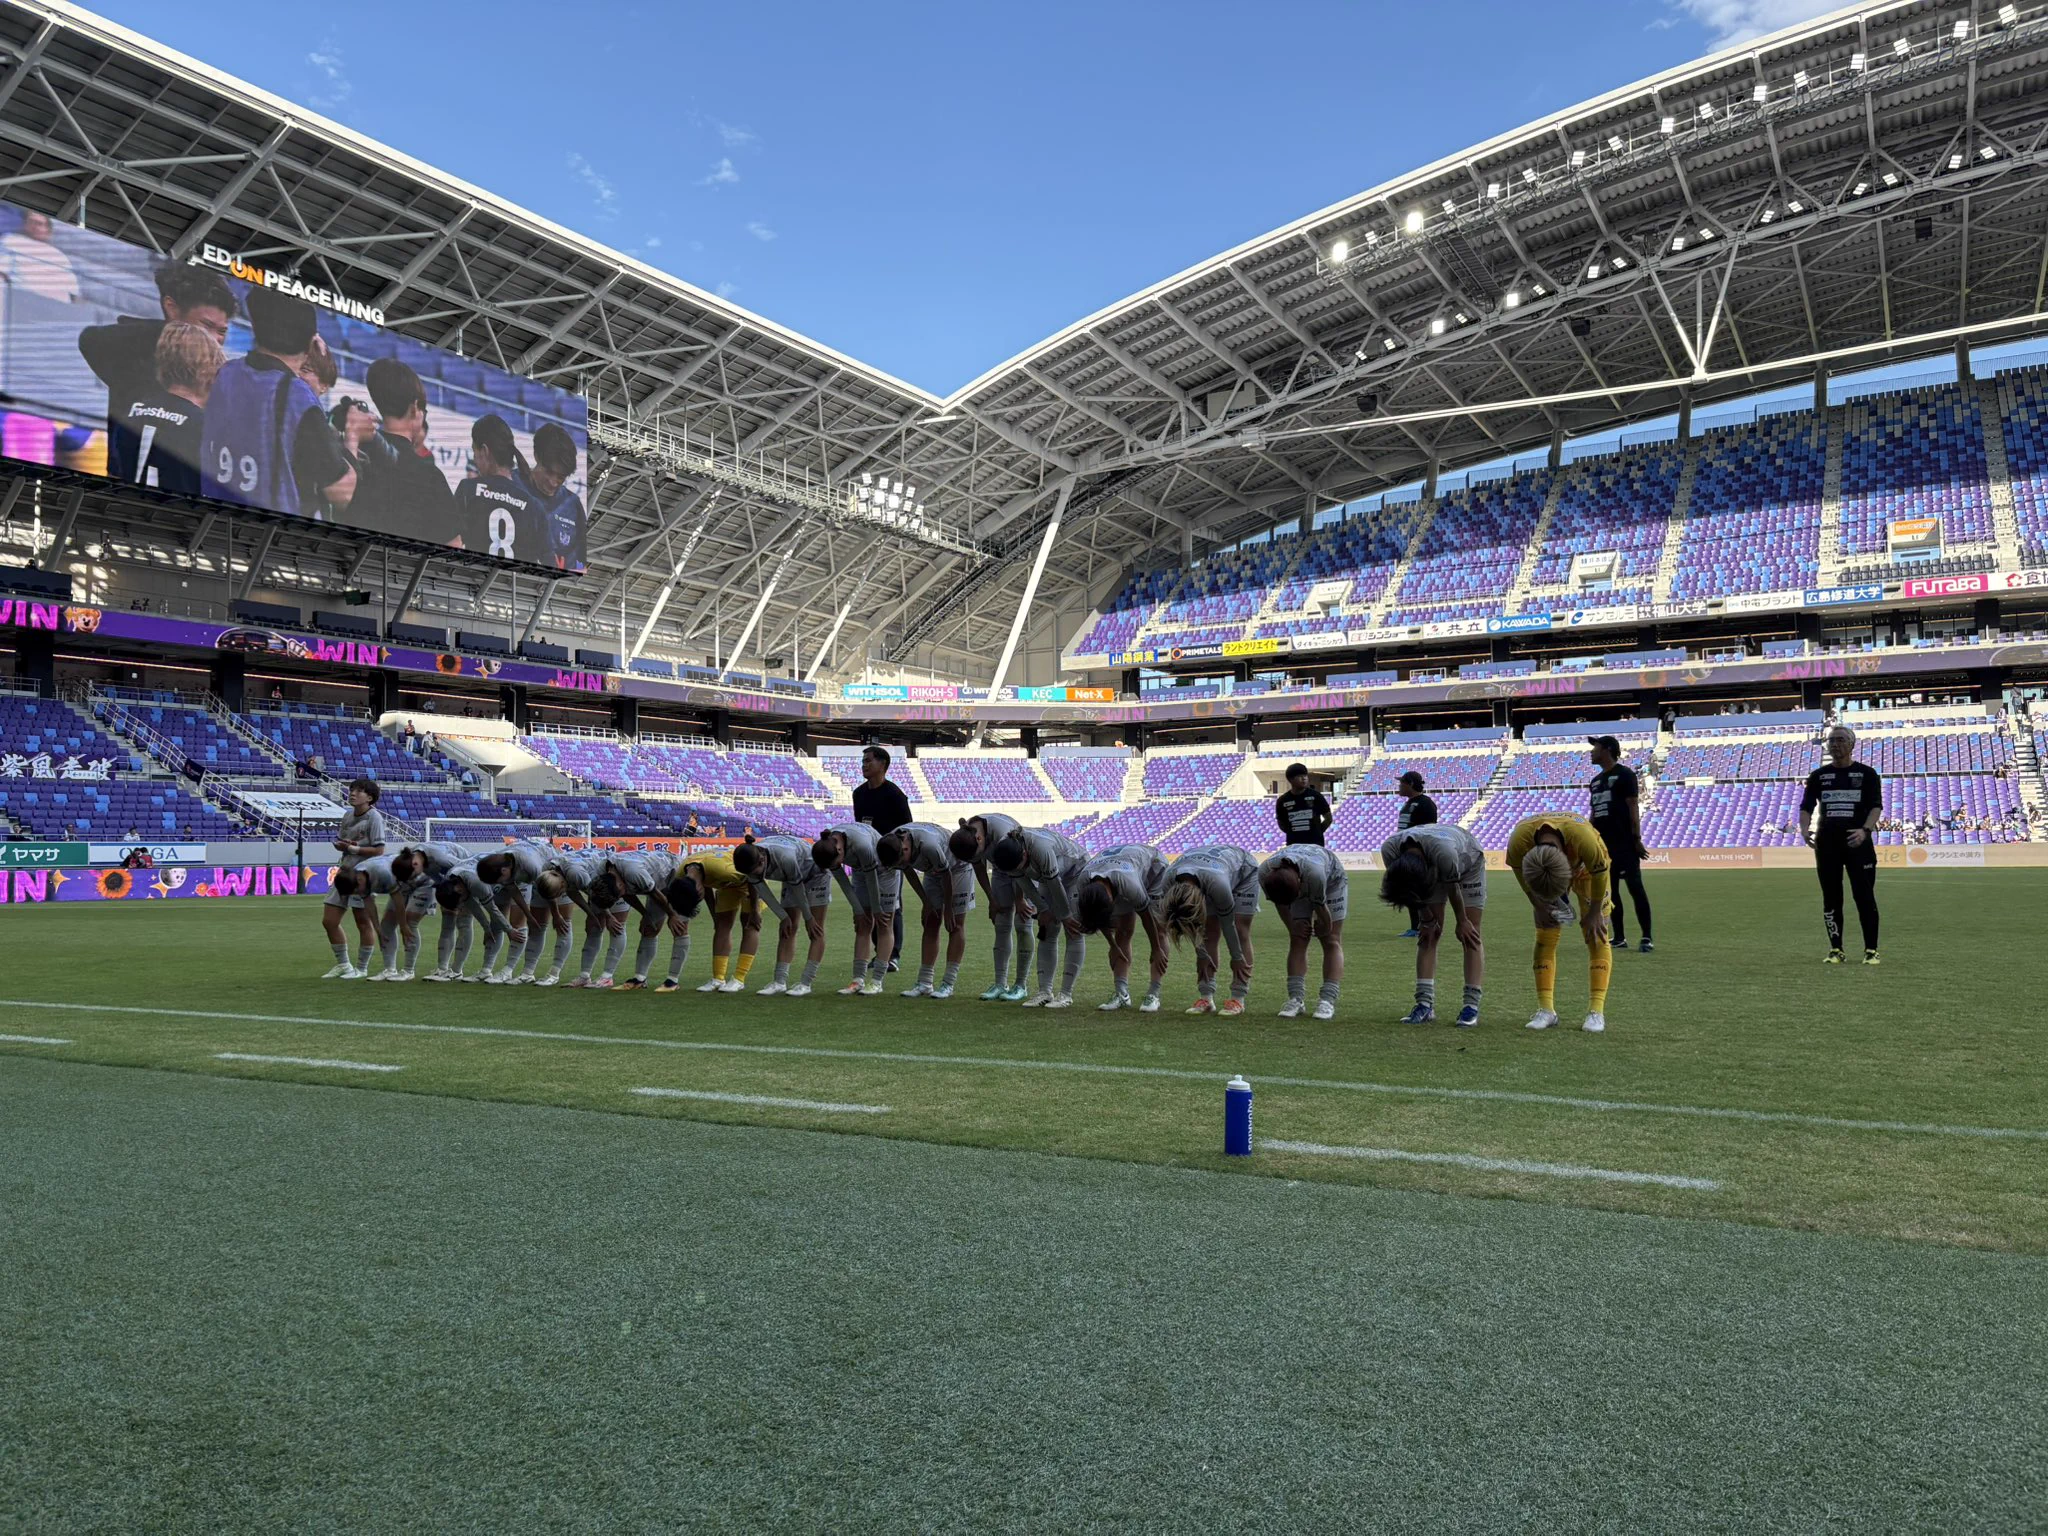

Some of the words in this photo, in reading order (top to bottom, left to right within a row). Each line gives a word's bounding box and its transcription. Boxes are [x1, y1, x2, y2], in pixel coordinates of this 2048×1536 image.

[476, 483, 527, 511] Forestway
[488, 508, 516, 559] 8
[1806, 586, 1881, 604] 広島修道大学
[1652, 601, 1707, 618] 福山大学
[1447, 622, 1482, 634] 共立
[1502, 616, 1549, 628] KAWADA
[317, 639, 378, 667] WIN
[1182, 647, 1222, 657] PRIMETALS
[1224, 641, 1277, 653] ランドクリエイト
[1786, 659, 1845, 679] WIN
[557, 669, 603, 691] WIN
[1525, 677, 1576, 693] WIN
[848, 687, 903, 696] WITHSOL
[911, 687, 953, 697] RIKOH-S
[1032, 689, 1053, 699] KEC
[1075, 689, 1104, 699] Net-X
[736, 693, 769, 711] WIN
[1300, 692, 1345, 710] WIN
[905, 706, 948, 720] WIN
[1105, 707, 1145, 721] WIN
[12, 848, 60, 862] ヤマサ
[119, 847, 179, 860] OGA
[1699, 853, 1719, 861] WEAR
[1735, 853, 1754, 861] HOPE
[0, 870, 48, 903] IN
[214, 866, 299, 896] WIN
